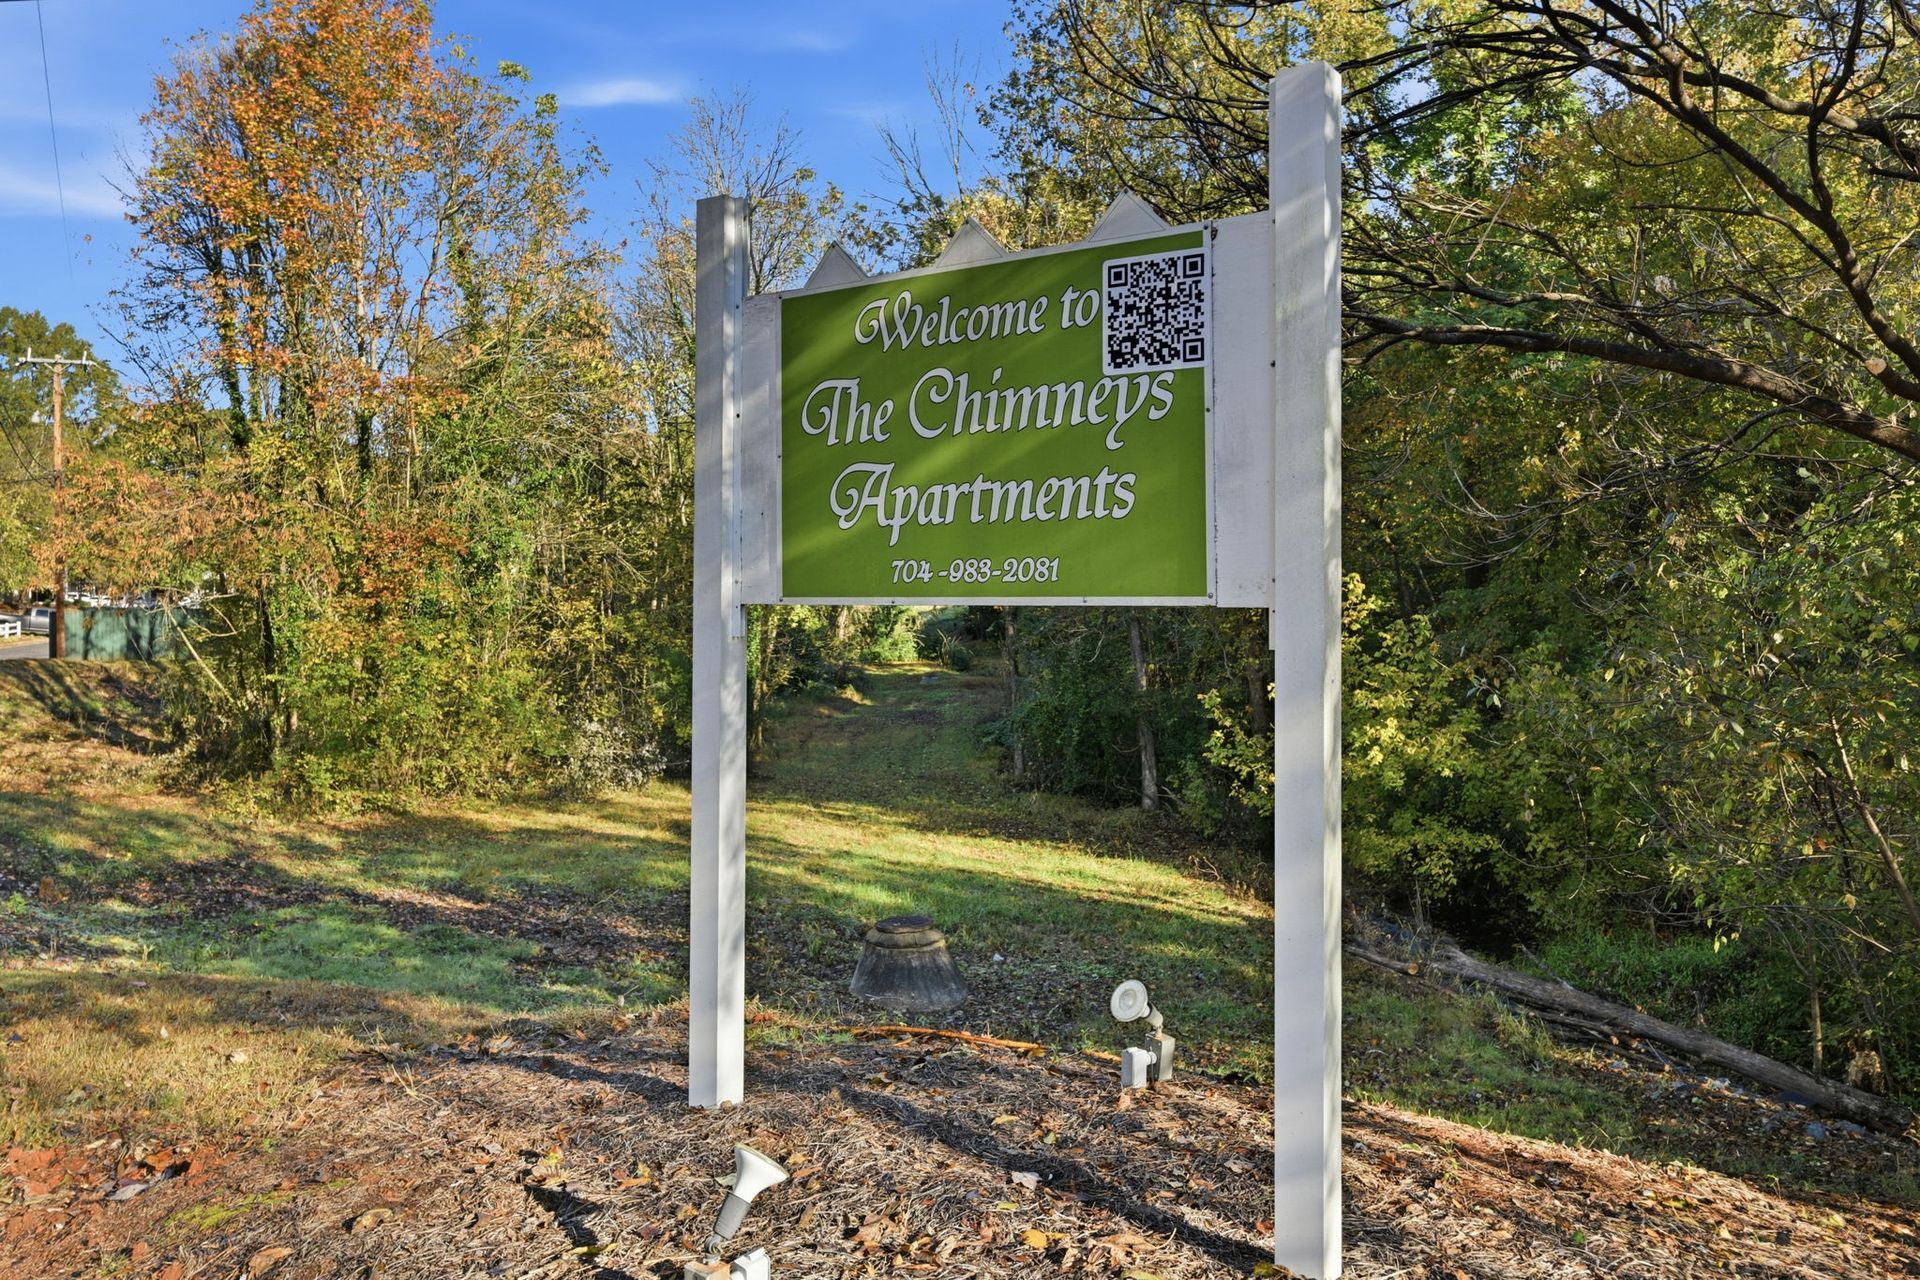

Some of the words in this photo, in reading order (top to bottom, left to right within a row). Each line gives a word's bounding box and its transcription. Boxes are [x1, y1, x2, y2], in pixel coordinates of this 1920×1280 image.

[854, 290, 1048, 353] Welcome
[1060, 284, 1100, 329] to
[801, 376, 894, 447] The
[908, 367, 1174, 450] Chimneys
[829, 462, 1136, 547] Apartments
[891, 557, 1059, 583] 704-983-2081
